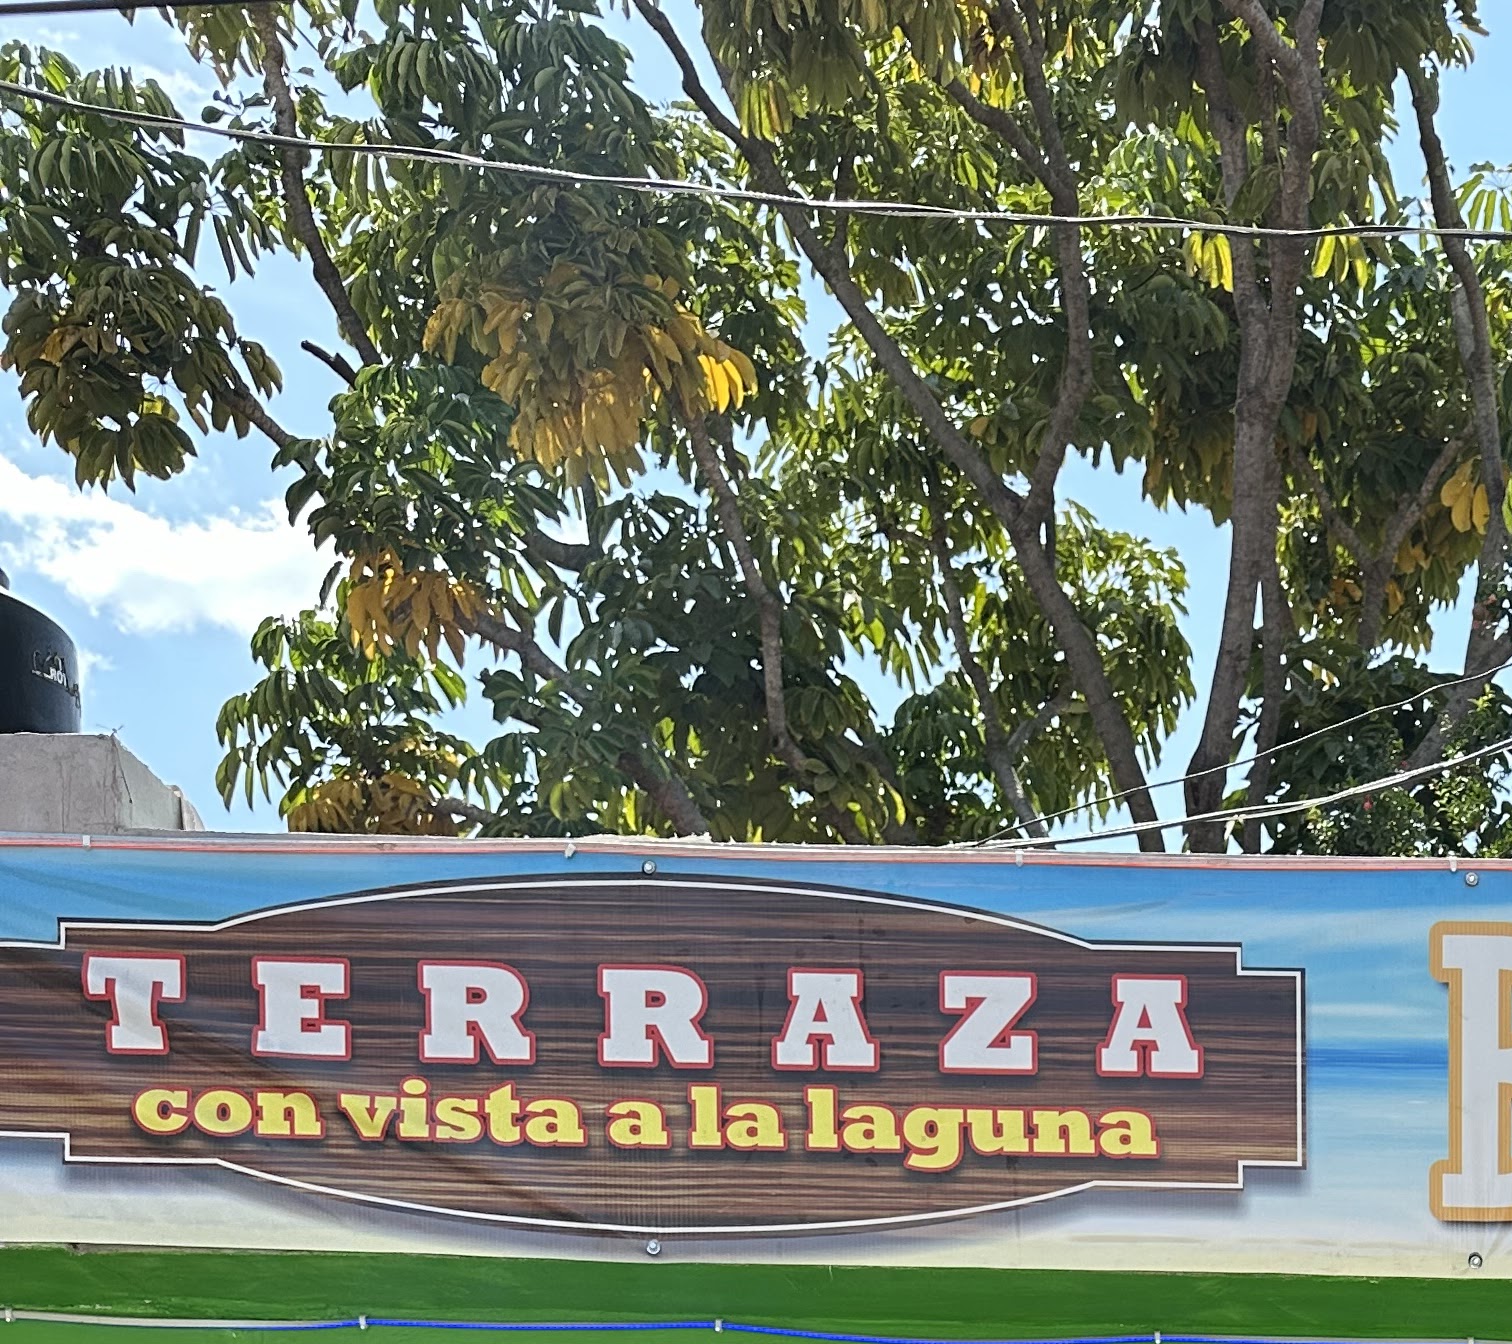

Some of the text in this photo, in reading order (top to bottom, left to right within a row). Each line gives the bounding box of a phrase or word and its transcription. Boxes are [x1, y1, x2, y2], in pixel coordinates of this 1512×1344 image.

[83, 951, 1204, 1077] TERRAZA
[131, 1077, 1159, 1172] con vista a la laguna
